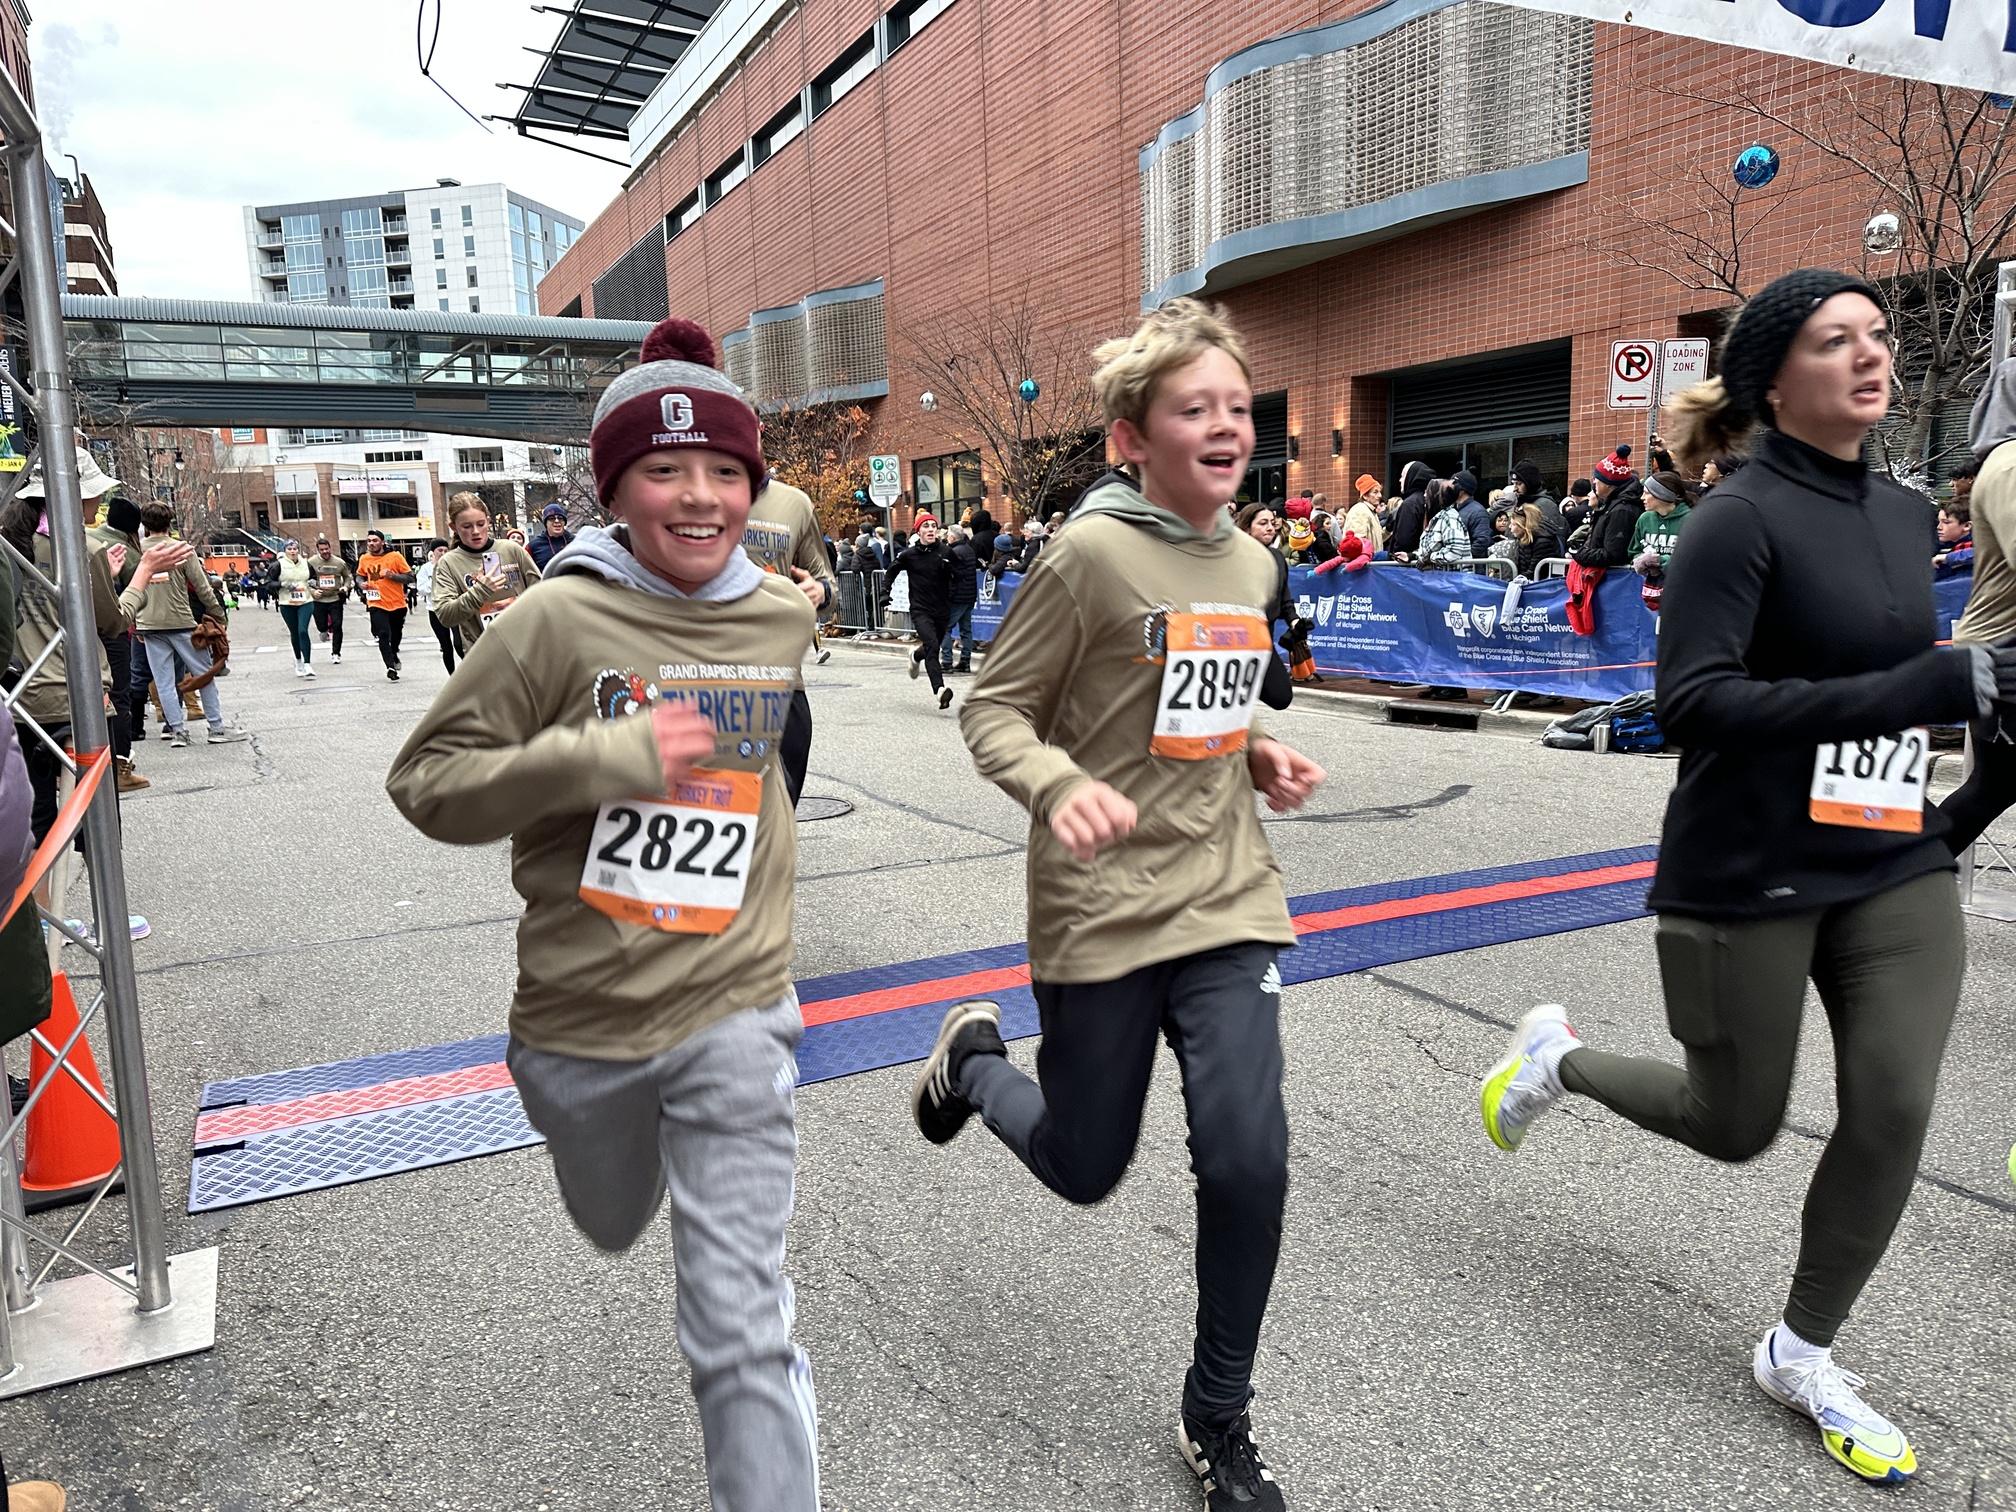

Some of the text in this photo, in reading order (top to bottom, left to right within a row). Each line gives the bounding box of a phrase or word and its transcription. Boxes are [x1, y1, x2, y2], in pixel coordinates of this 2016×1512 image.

[1667, 348, 1704, 358] LOADING
[1673, 362, 1695, 371] ZONE
[1, 385, 14, 413] MEIJER
[660, 393, 694, 431] G
[651, 431, 709, 444] FOOTBALL
[741, 528, 790, 551] URKEY TROT
[1338, 595, 1372, 604] Blue Cross
[1337, 603, 1373, 612] Blue Shield
[1524, 606, 1548, 614] Cross
[1336, 611, 1398, 622] Blue Care Network
[1520, 614, 1549, 624] Shield
[1342, 621, 1362, 630] Michigan
[1521, 623, 1544, 632] Care
[1544, 623, 1574, 632] Netwo
[1347, 636, 1375, 644] independent
[1375, 637, 1399, 645] licensees
[1512, 633, 1540, 643] Michigan
[1347, 642, 1361, 650] Shield
[1361, 643, 1390, 651] Association
[1456, 644, 1480, 653] Nonprofit
[1480, 647, 1513, 655] corporations
[1525, 649, 1561, 657] independent
[1561, 651, 1590, 659] licensees
[1472, 652, 1485, 660] Blue
[1485, 653, 1501, 661] Cross
[1526, 655, 1545, 663] Shield
[1545, 657, 1580, 666] Association
[658, 664, 698, 680] GRAND
[699, 664, 737, 680] RAPIDS
[737, 664, 770, 681] PUBLIC
[1167, 657, 1260, 710] 2899
[1825, 733, 1920, 783] 1872
[597, 806, 747, 879] 2822
